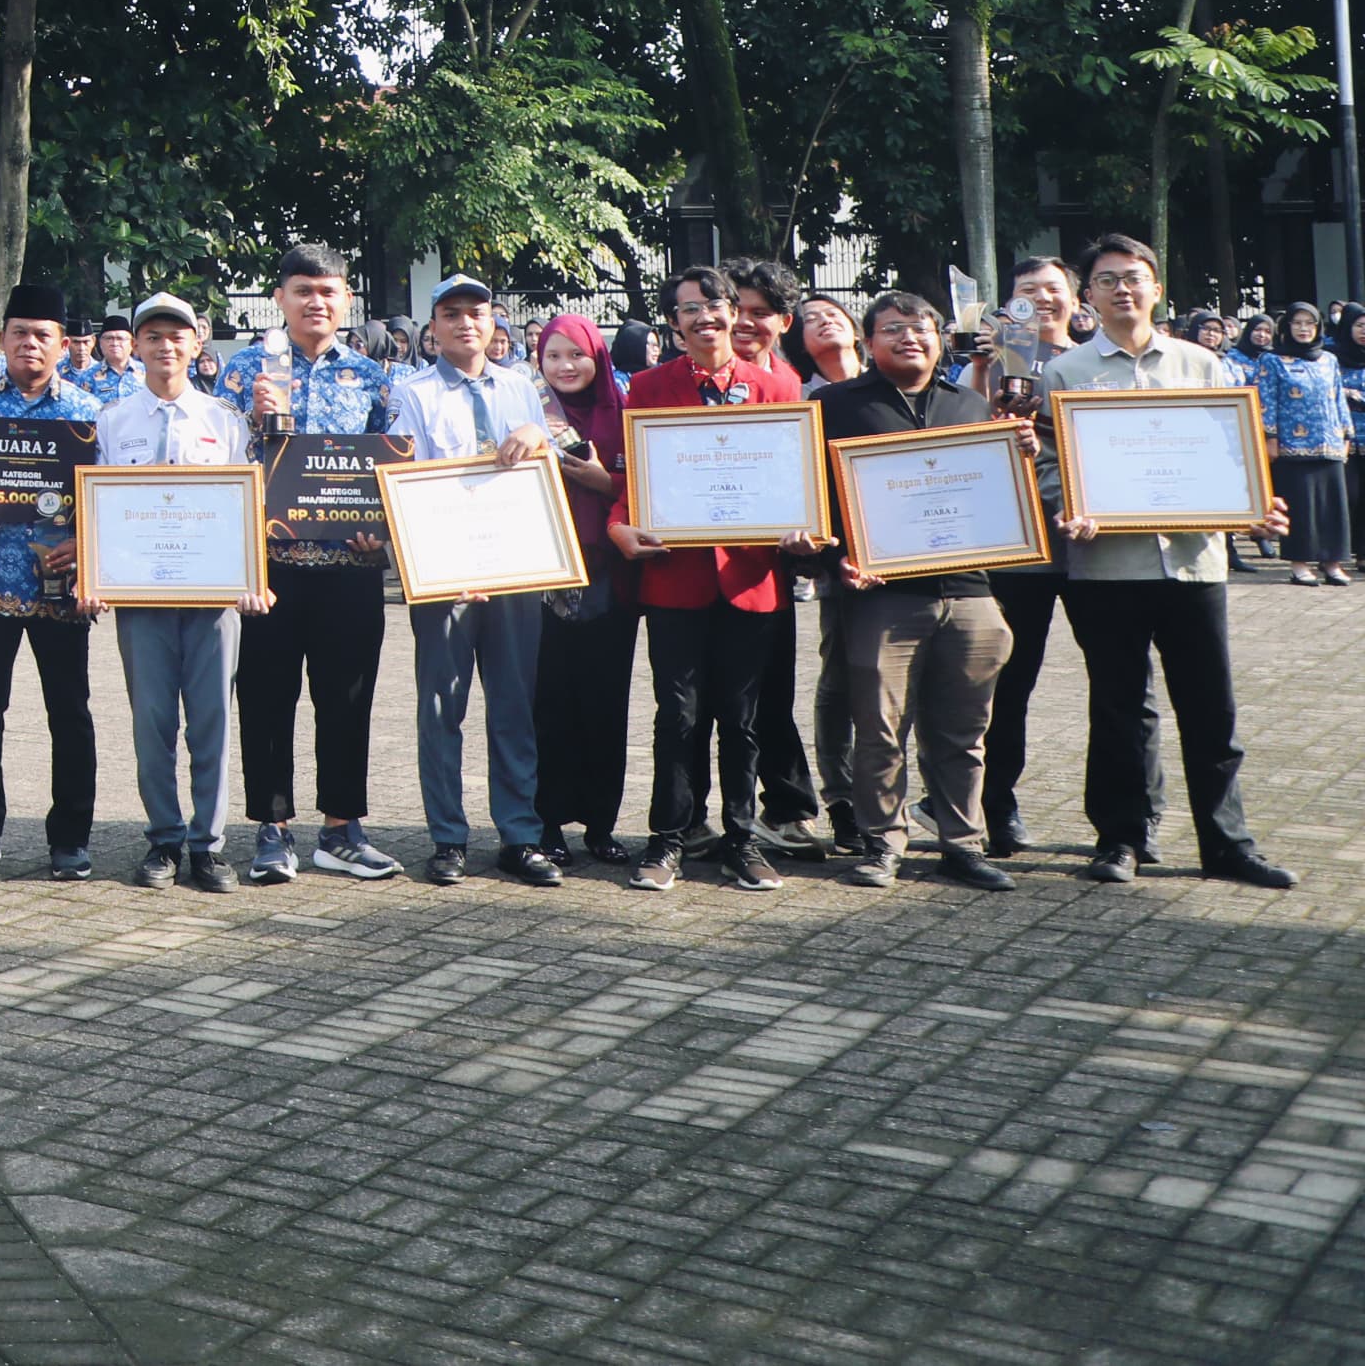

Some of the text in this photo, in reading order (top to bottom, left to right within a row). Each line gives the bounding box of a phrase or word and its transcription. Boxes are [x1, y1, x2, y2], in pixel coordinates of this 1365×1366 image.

[47, 441, 57, 455] 2
[305, 455, 375, 471] JUARA 3
[2, 470, 42, 480] KATEGORI
[320, 488, 361, 496] KATEGORI
[709, 484, 737, 492] JUARA
[287, 509, 385, 522] RP. 3.000.00
[154, 543, 181, 551] JUARA
